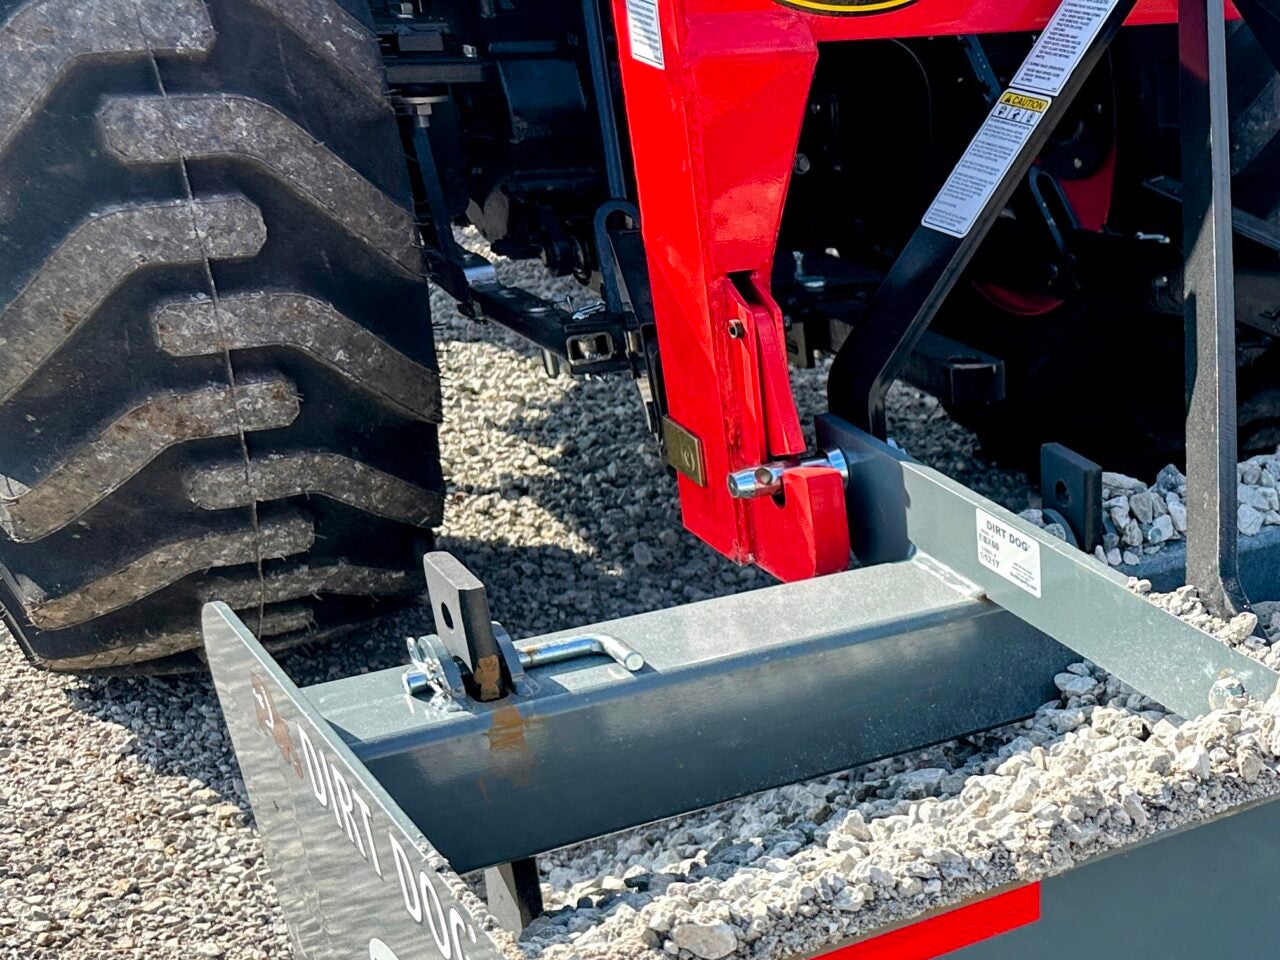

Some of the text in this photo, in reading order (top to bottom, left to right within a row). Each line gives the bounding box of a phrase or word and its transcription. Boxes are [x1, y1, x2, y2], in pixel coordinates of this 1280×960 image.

[1012, 96, 1045, 110] CAUTION
[986, 520, 1006, 539] DIRT
[1009, 533, 1029, 552] DOG
[296, 720, 384, 881] DIRT
